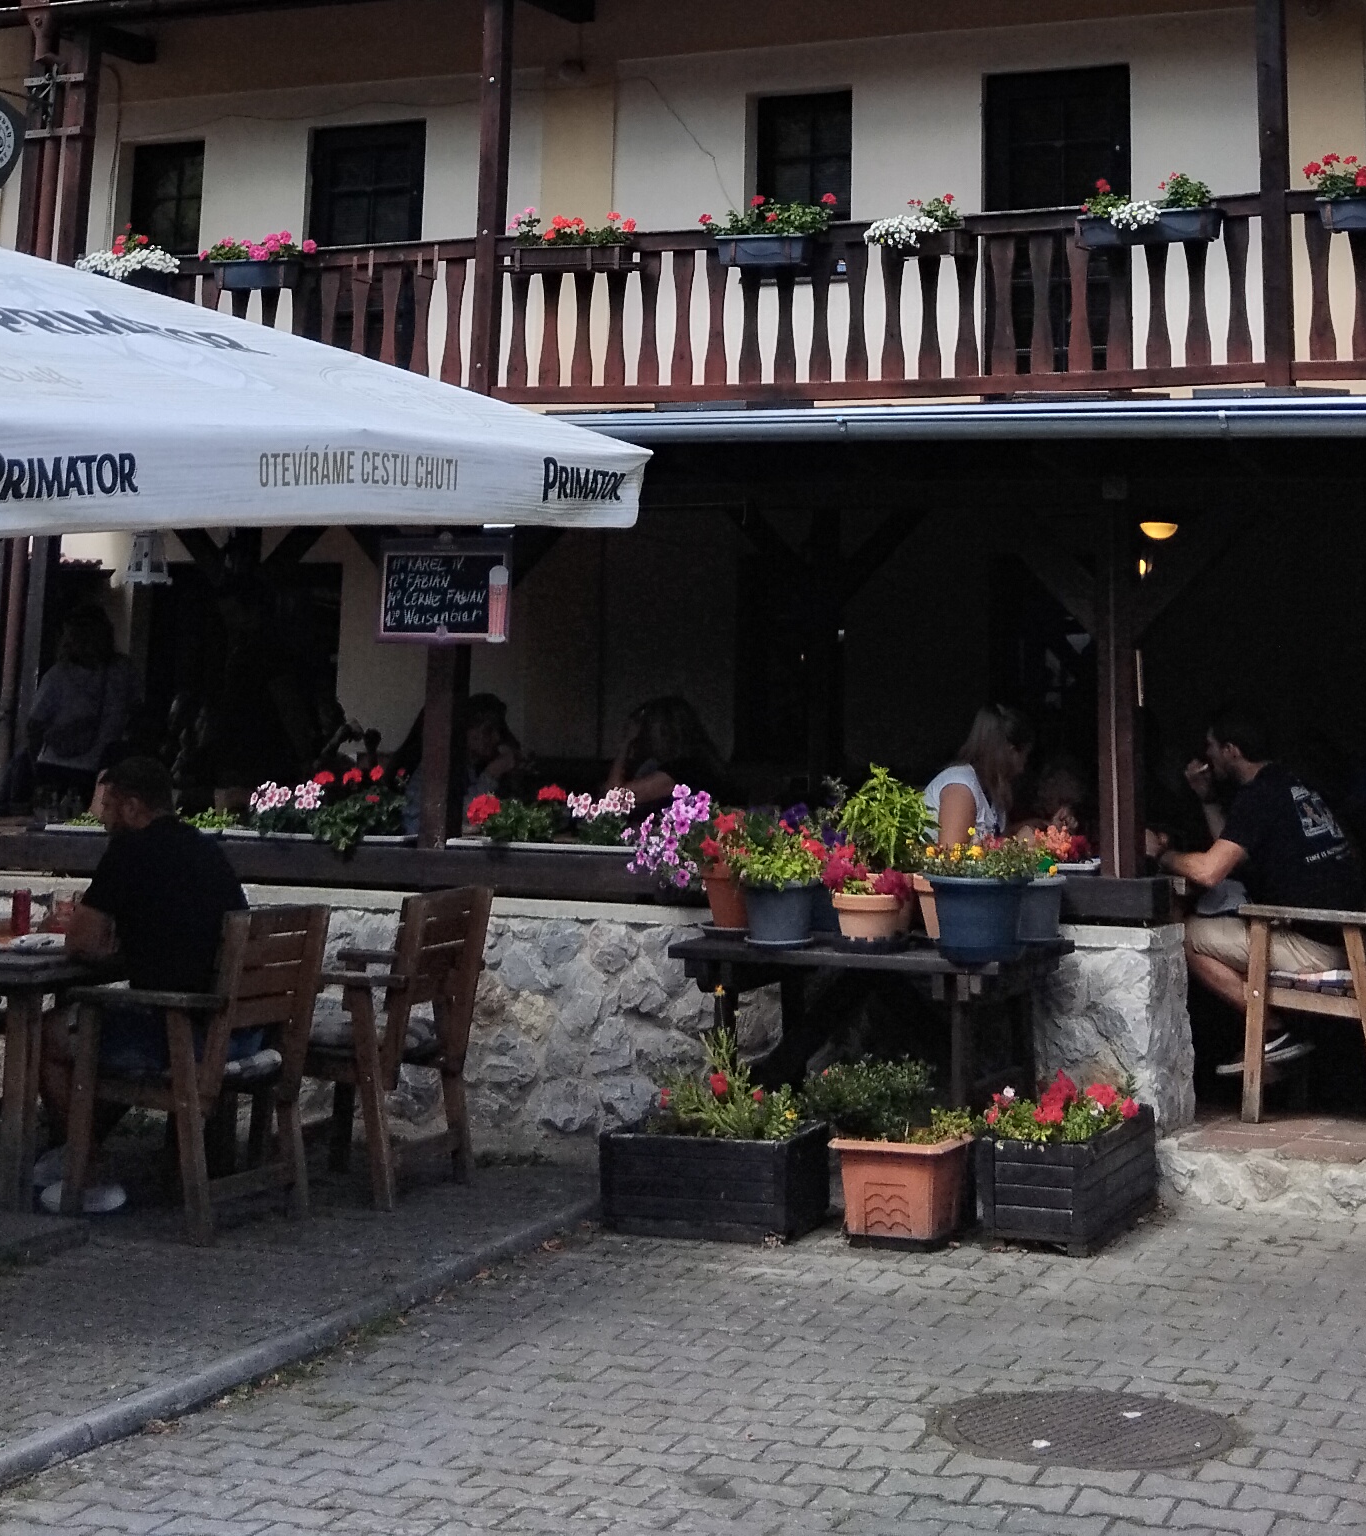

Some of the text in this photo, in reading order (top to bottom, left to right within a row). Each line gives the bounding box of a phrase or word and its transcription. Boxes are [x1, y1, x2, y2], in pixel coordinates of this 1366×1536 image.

[259, 444, 459, 491] OTEVÍRÁME CESTU CHUTI
[542, 456, 627, 504] PRIMATOR
[408, 556, 447, 572] KAREL
